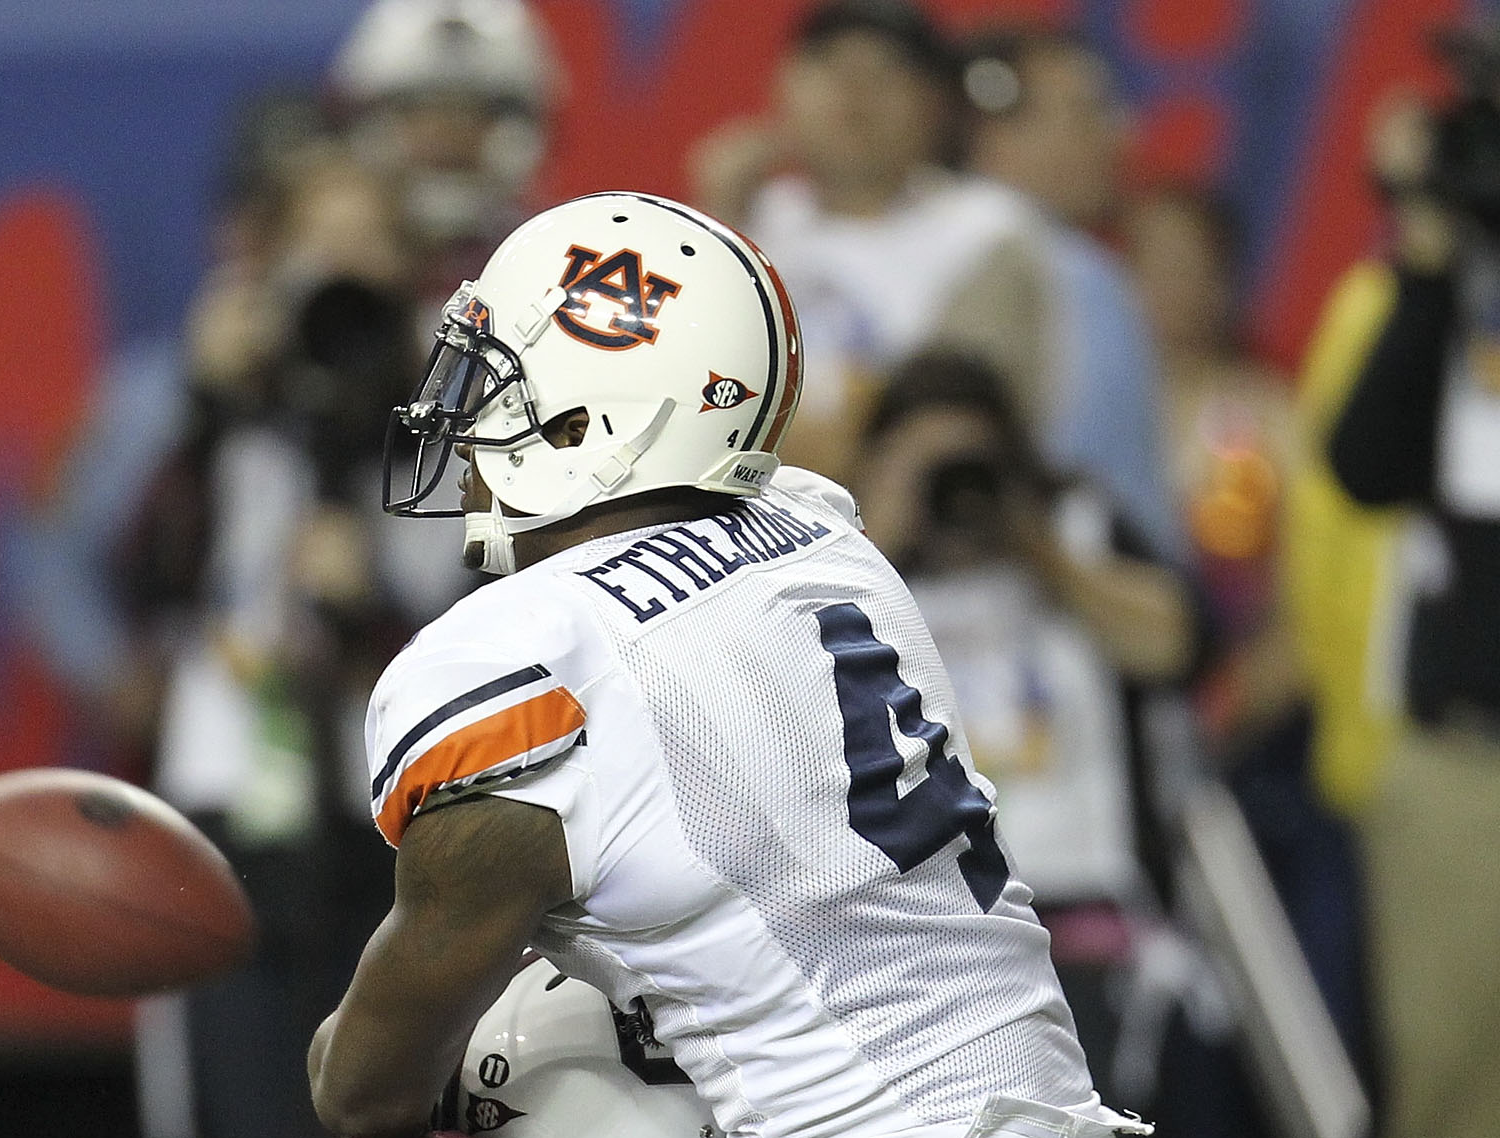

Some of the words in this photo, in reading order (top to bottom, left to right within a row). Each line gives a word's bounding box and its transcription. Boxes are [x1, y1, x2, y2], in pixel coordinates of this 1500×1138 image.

[712, 379, 739, 408] SEC
[726, 429, 740, 448] 4
[814, 602, 1010, 914] 4
